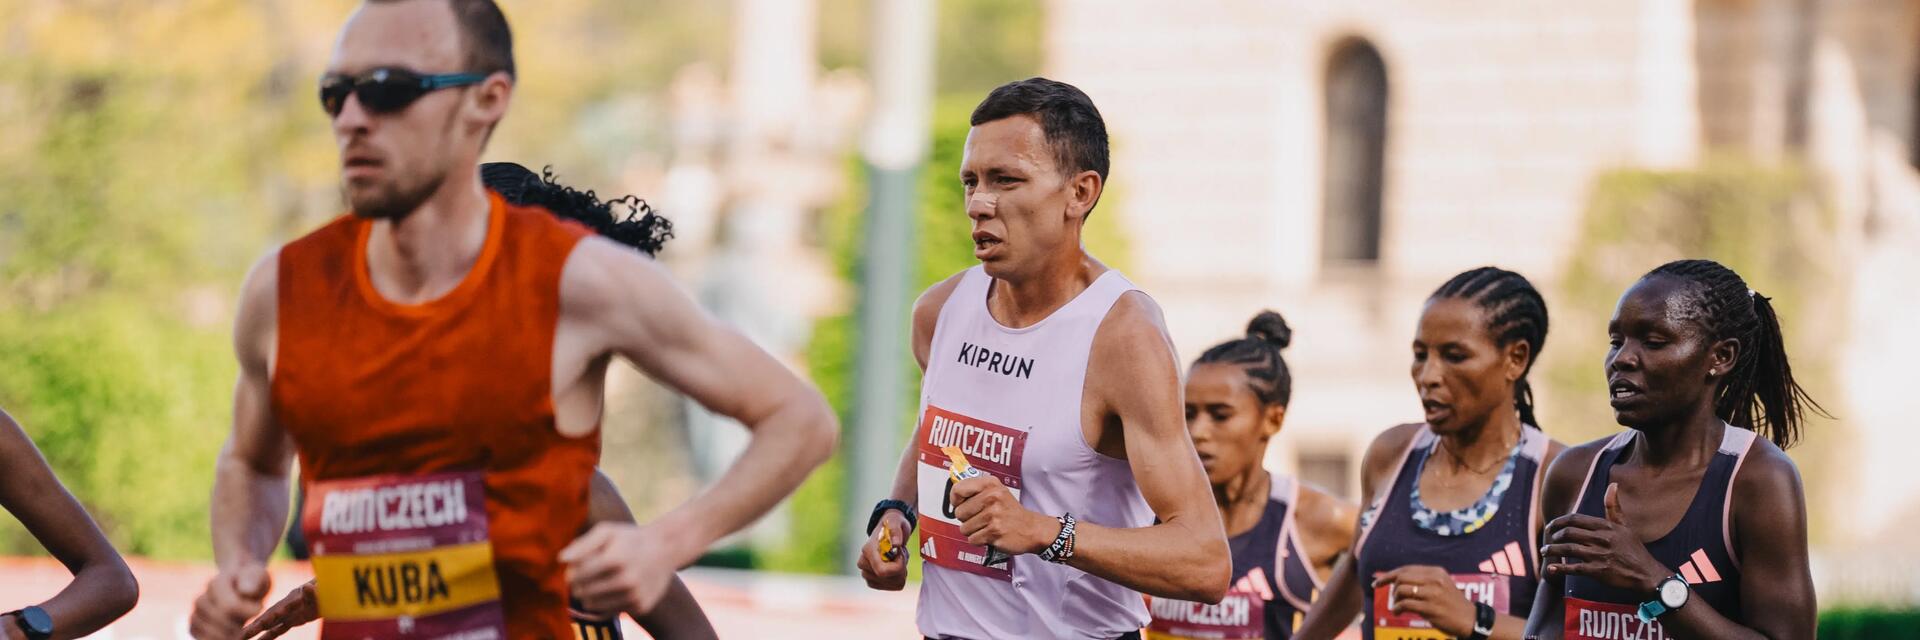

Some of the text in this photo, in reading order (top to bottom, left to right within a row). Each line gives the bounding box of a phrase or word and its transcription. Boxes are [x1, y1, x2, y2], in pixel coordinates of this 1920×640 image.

[957, 342, 1034, 379] KIPRUN
[928, 415, 1014, 466] RUNCZECH
[320, 479, 467, 535] RUNCZECH
[353, 559, 449, 606] KUBA
